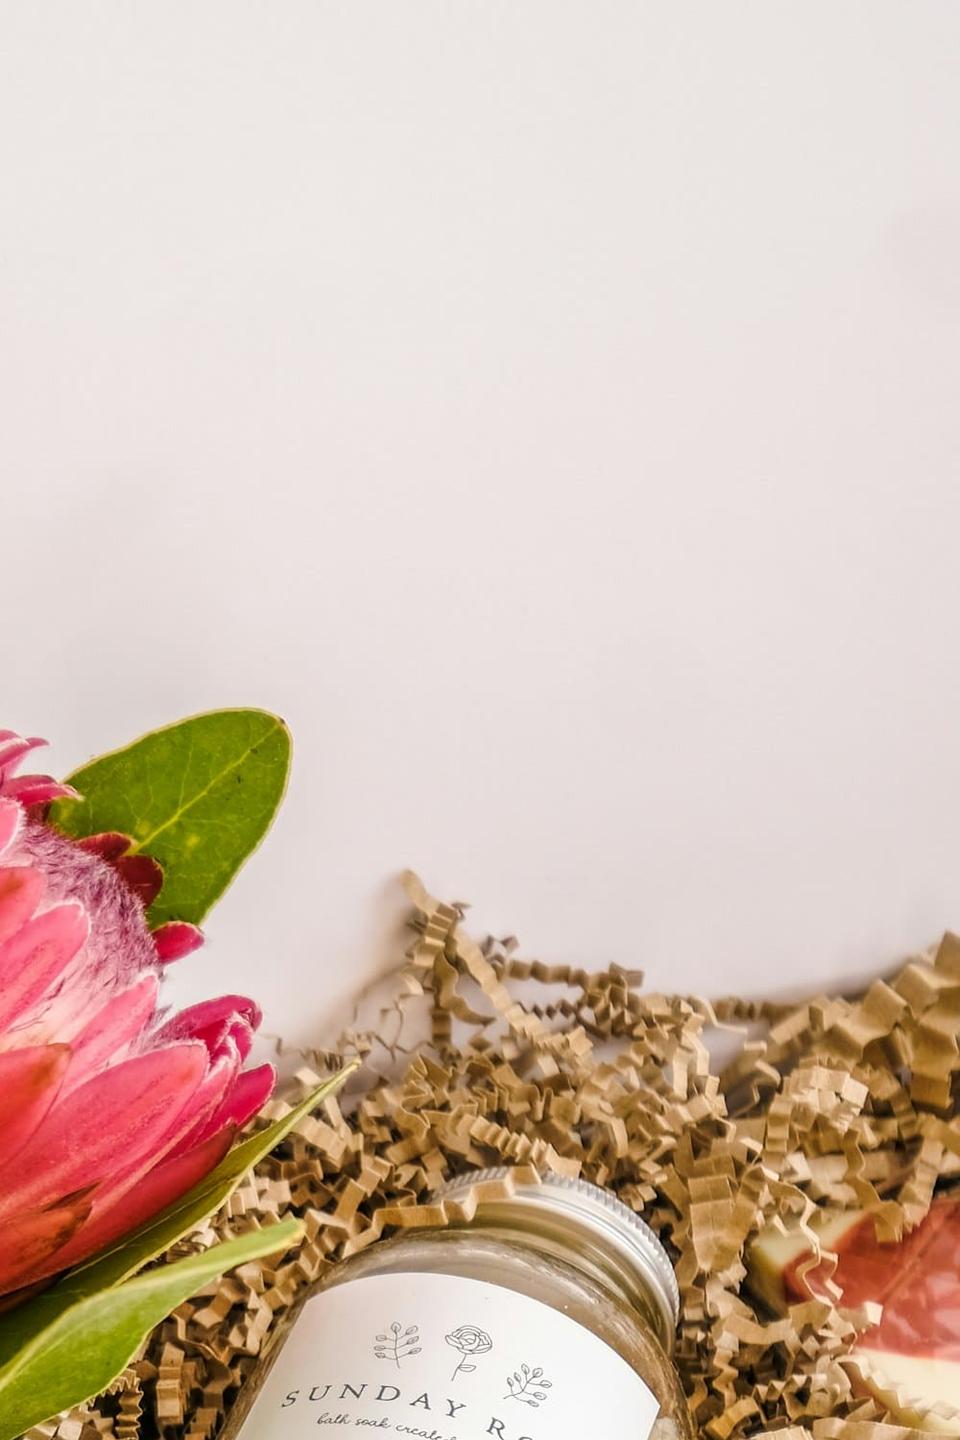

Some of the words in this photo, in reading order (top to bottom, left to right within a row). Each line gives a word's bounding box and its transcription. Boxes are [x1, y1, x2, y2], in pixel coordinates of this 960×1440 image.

[282, 1384, 466, 1418] SUNDAY
[317, 1412, 350, 1425] bath
[355, 1414, 391, 1429] soak
